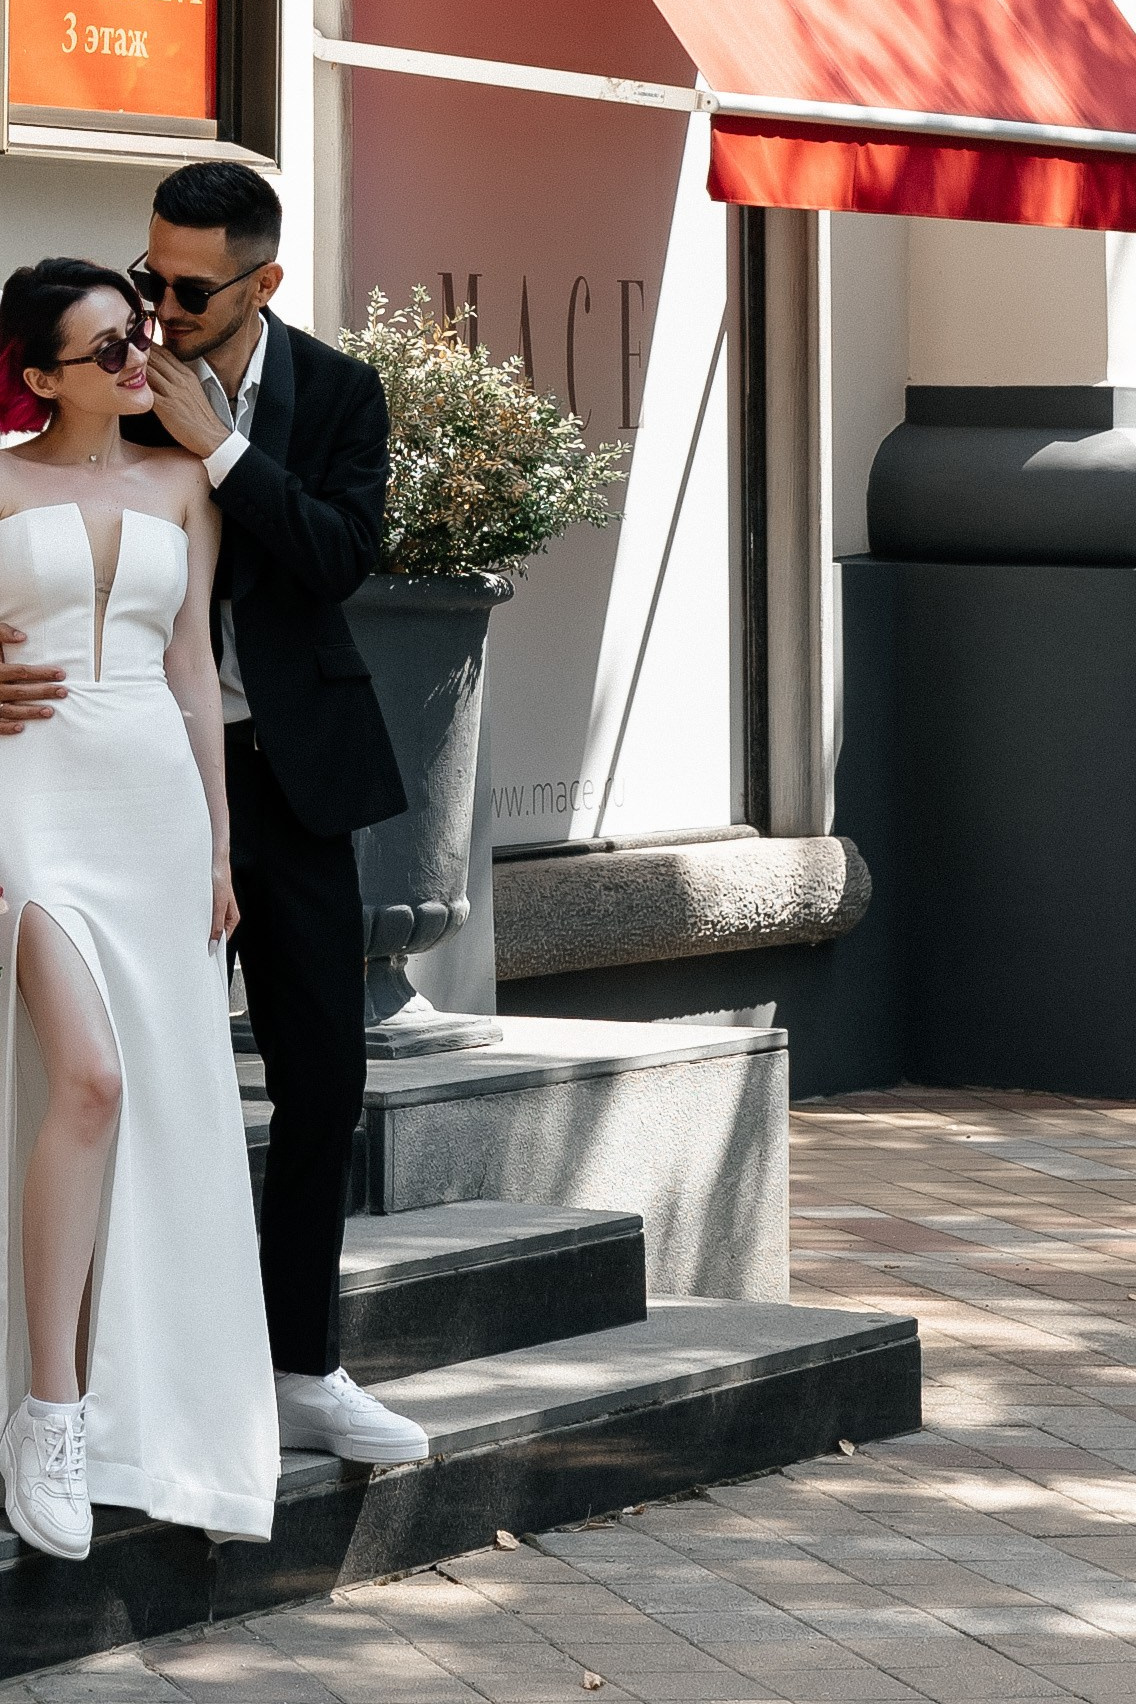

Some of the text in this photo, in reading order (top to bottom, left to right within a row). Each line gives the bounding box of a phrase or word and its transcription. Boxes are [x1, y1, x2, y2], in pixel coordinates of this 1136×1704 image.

[61, 11, 150, 59] 3 этаж
[437, 271, 645, 431] MACE
